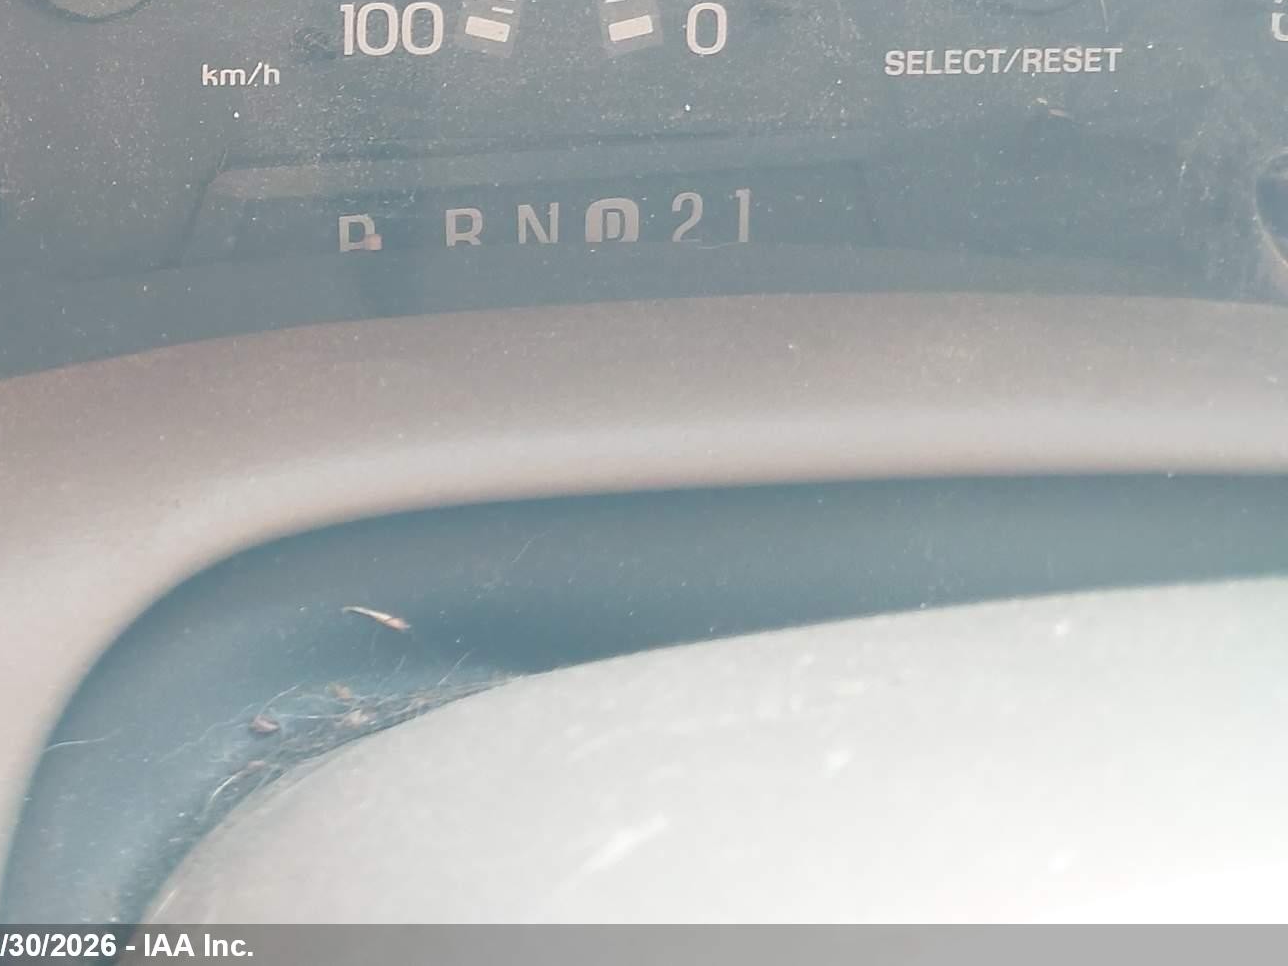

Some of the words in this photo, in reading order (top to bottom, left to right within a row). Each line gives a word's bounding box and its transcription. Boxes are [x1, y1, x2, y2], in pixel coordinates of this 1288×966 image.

[340, 1, 444, 56] 100
[686, 2, 728, 55] 0
[201, 63, 281, 87] km/h
[884, 48, 1122, 76] SELECT/RESET
[445, 208, 484, 247] R
[517, 202, 559, 245] N
[671, 192, 703, 242] 2
[734, 188, 752, 242] 1
